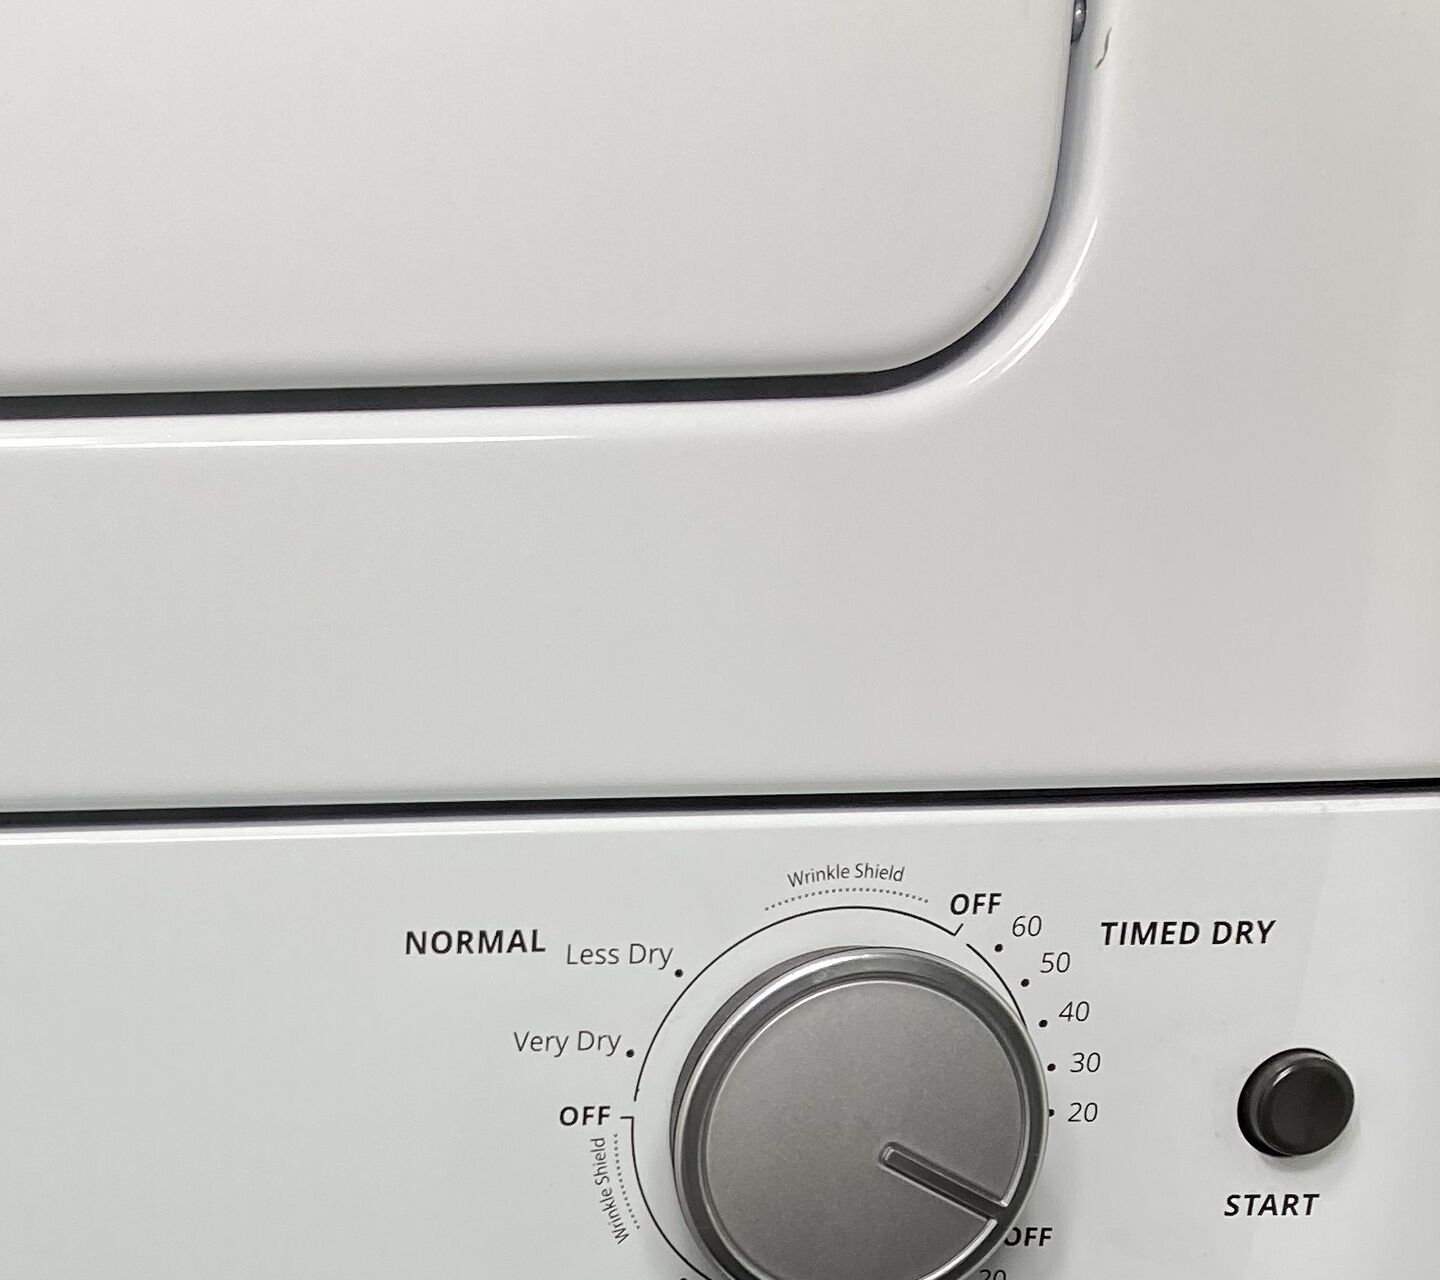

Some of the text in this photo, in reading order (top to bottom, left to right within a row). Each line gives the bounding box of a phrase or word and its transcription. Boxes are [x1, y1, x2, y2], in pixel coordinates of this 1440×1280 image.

[787, 862, 905, 888] Wrinkle Shield
[950, 892, 1002, 916] OFF
[1012, 915, 1042, 938] 60
[1100, 919, 1277, 946] TIMED DRY
[405, 929, 546, 955] NORMAL
[566, 942, 673, 972] Less Dry
[1040, 951, 1071, 974] 50
[1058, 1000, 1090, 1022] 40
[513, 1030, 622, 1058] Very Dry
[1069, 1051, 1101, 1073] 30
[559, 1105, 611, 1127] OFF
[1067, 1102, 1098, 1123] 20
[591, 1137, 628, 1244] Wrinkle Shield
[1223, 1193, 1321, 1217] START
[1003, 1226, 1053, 1247] OFF
